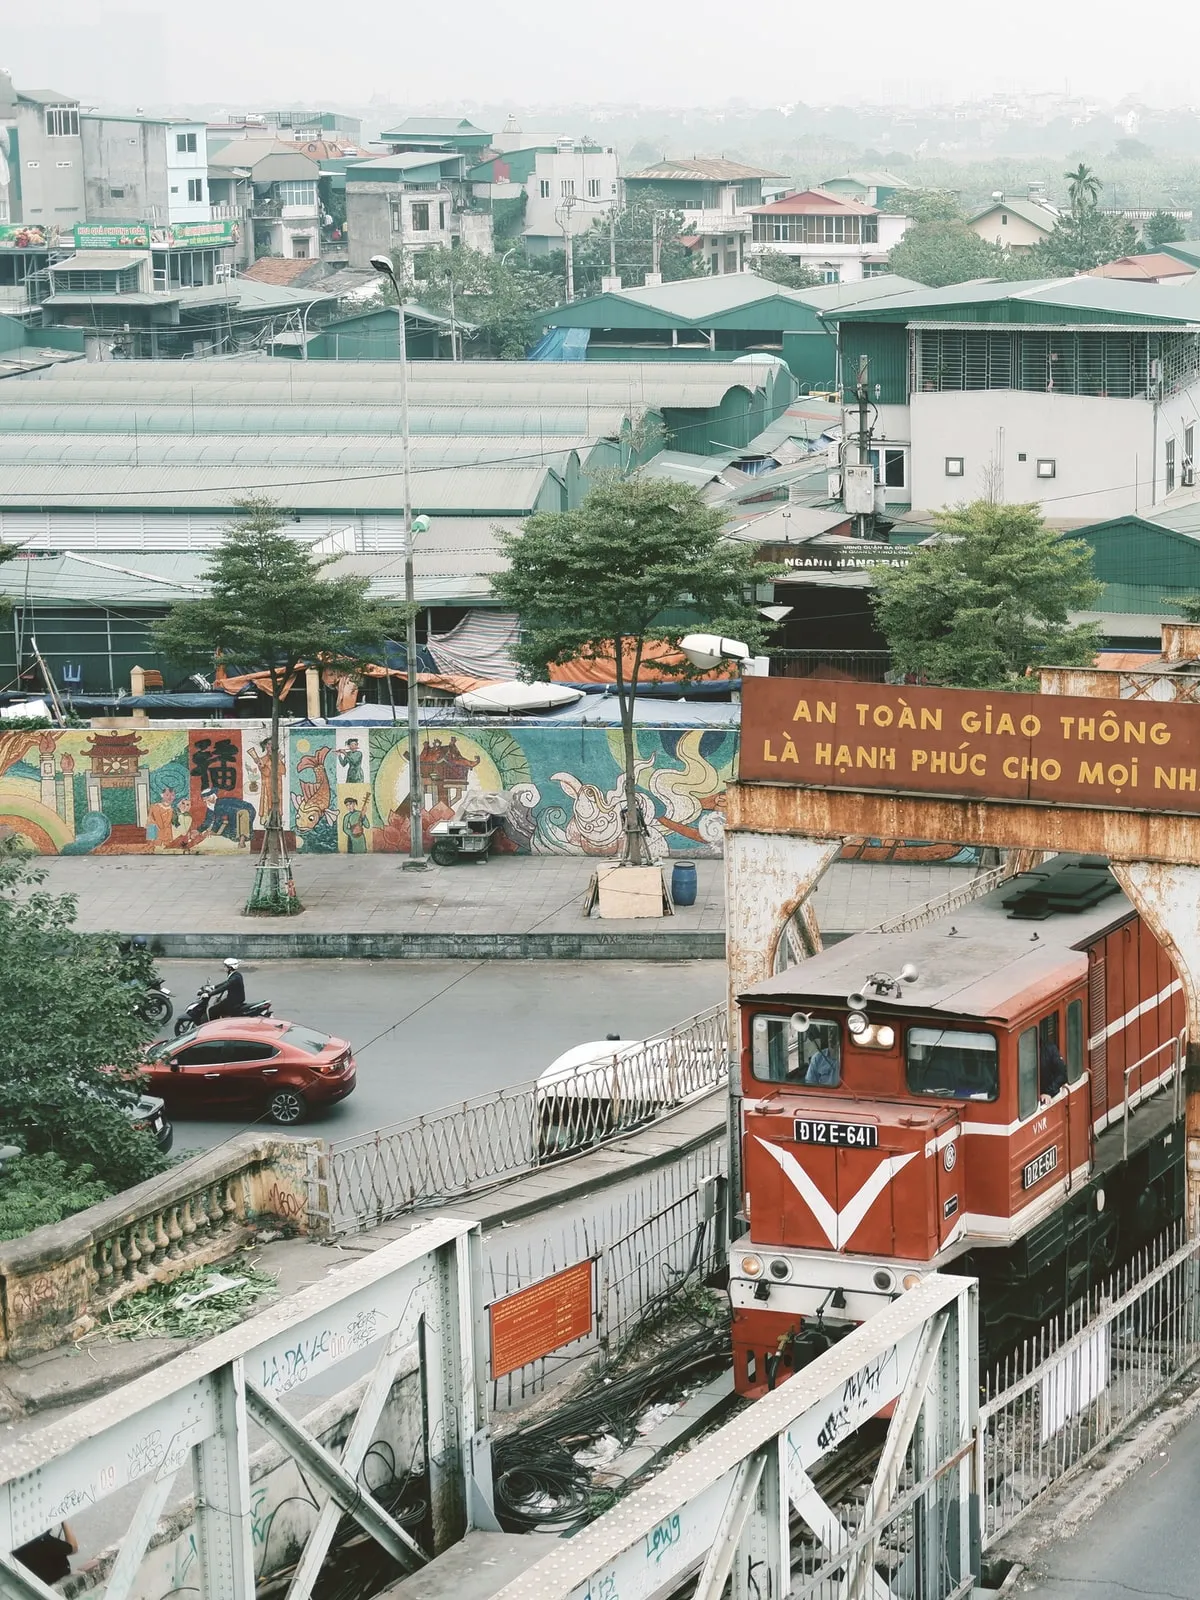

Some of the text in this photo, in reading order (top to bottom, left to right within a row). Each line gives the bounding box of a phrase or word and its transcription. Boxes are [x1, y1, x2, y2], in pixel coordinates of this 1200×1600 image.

[792, 700, 837, 724] AN
[856, 697, 943, 731] TOÀN
[1060, 710, 1171, 745] THÔNG
[764, 731, 800, 764] LÀ
[815, 742, 896, 774] HẠNH
[911, 741, 987, 777] PHÚC
[1002, 756, 1061, 781] CHO
